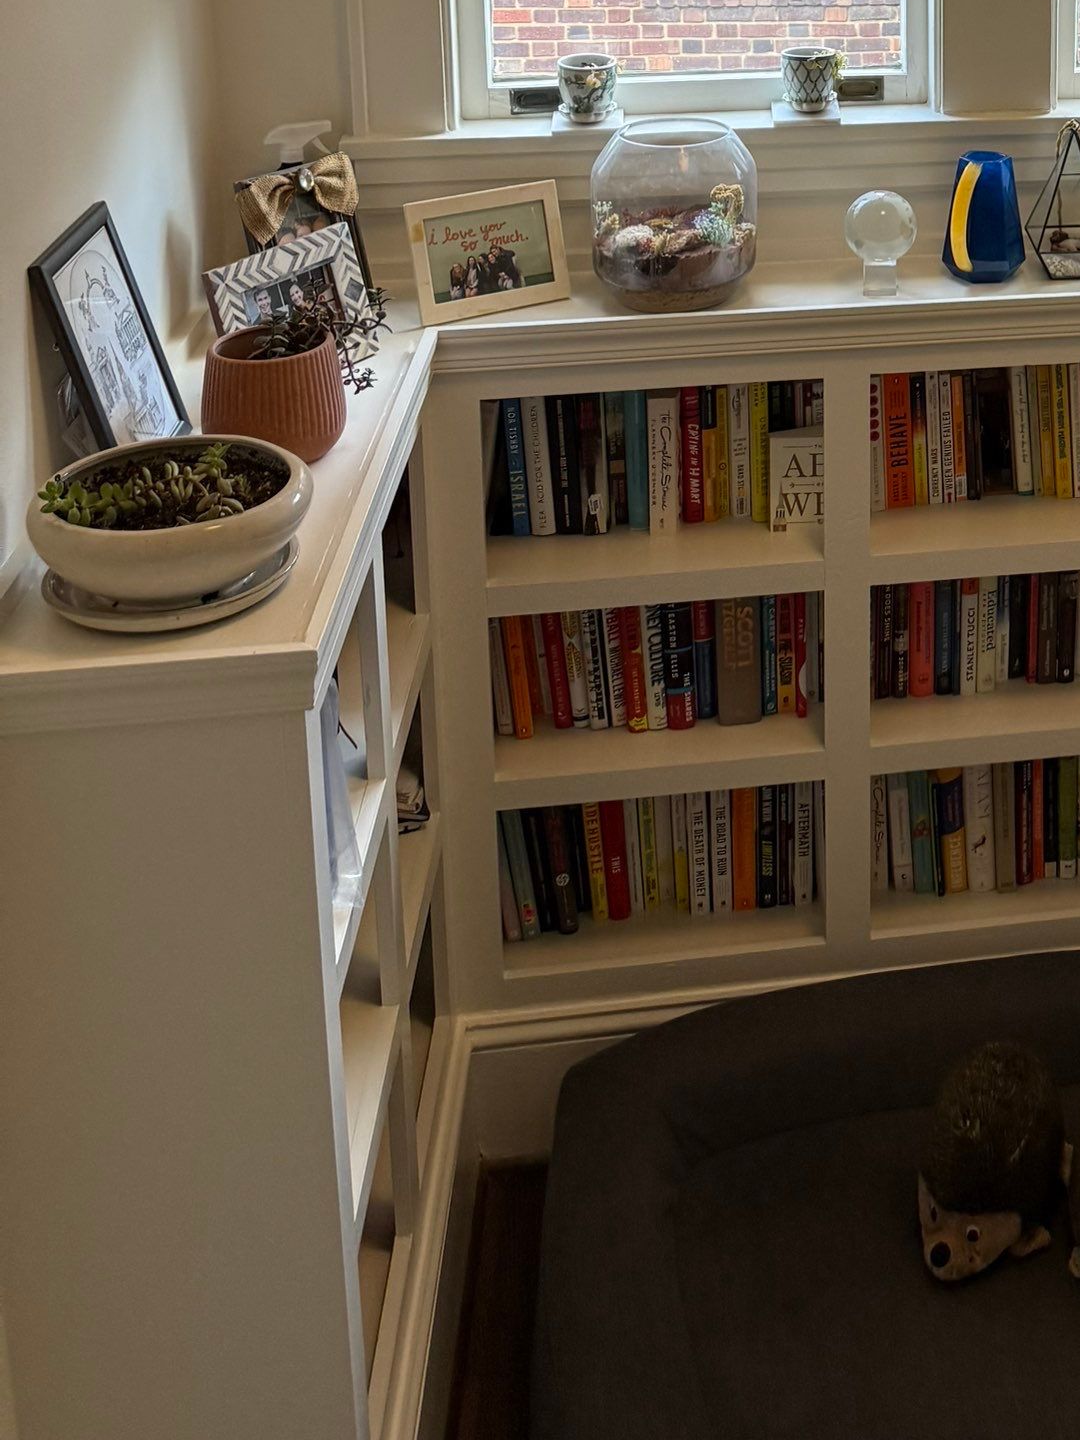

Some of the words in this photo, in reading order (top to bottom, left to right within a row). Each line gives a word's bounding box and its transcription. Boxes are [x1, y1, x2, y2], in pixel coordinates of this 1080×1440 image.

[428, 228, 437, 246] i
[442, 225, 476, 243] love
[480, 221, 506, 241] you
[461, 237, 478, 252] so
[942, 411, 951, 437] FAILED
[687, 423, 700, 455] CRYING
[888, 412, 909, 468] BEHAVE
[943, 440, 952, 466] GENIUS
[689, 478, 701, 505] MART
[944, 468, 953, 490] WHEN
[510, 469, 526, 518] ISRAEL
[605, 608, 620, 644] YBALL
[966, 607, 975, 636] TUCCI
[986, 590, 997, 652] Educated
[735, 606, 754, 668] SCOTT
[608, 644, 625, 684] MICHAEL
[648, 633, 666, 687] CULTURE
[966, 640, 974, 682] STANLEY
[613, 684, 626, 709] LEWIS
[693, 810, 704, 826] THE
[715, 806, 726, 821] THE
[694, 829, 704, 854] DEATH
[716, 822, 726, 844] ROAD
[798, 803, 810, 857] AFTERMATH
[587, 826, 603, 875] HUSTLE
[695, 857, 705, 867] OF
[717, 845, 727, 856] TO
[611, 856, 621, 874] THIS
[717, 858, 727, 876] RUIN
[696, 869, 706, 898] MONEY
